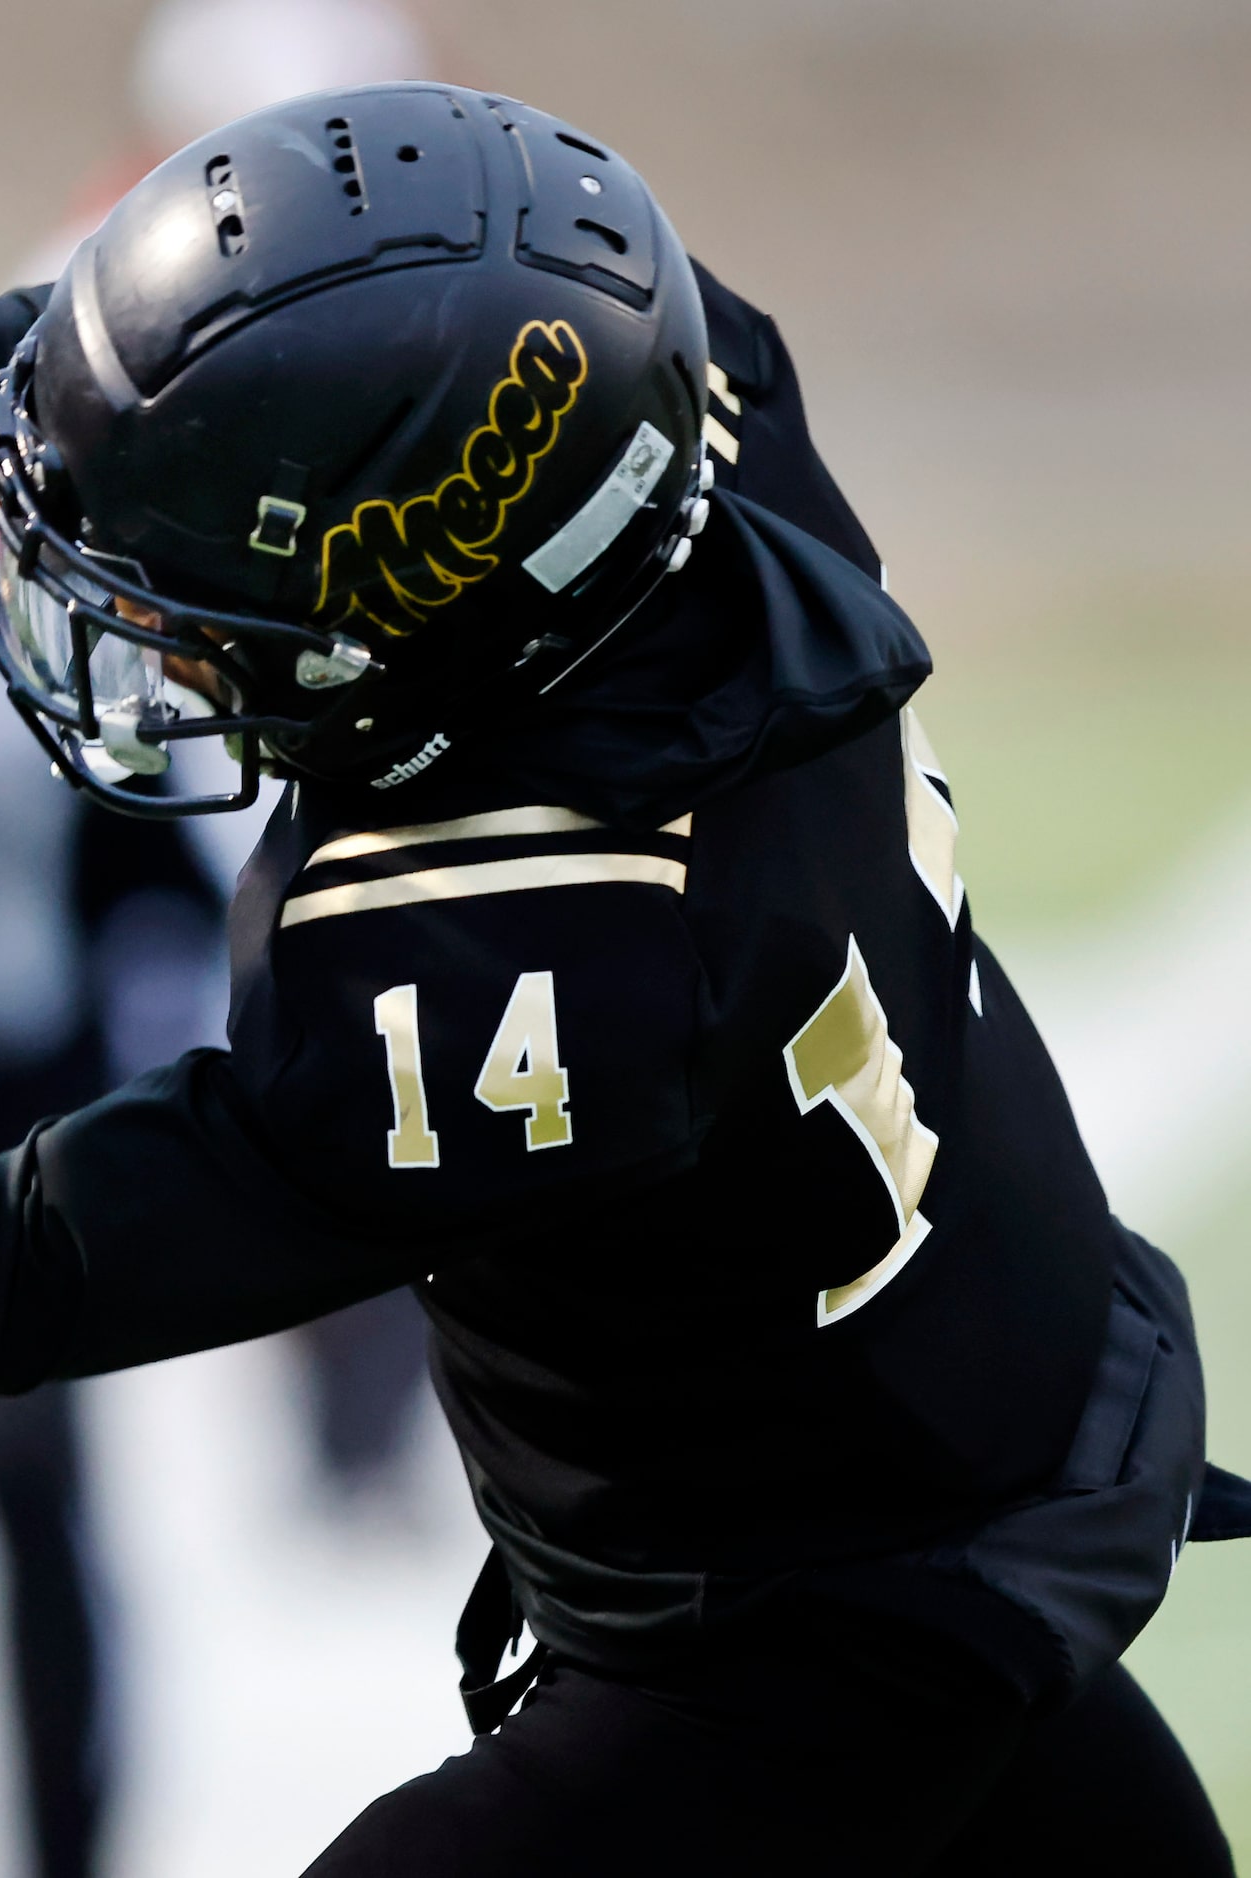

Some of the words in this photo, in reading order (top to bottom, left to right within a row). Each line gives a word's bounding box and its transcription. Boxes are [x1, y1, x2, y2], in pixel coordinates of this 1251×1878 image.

[312, 319, 588, 636] Mecca
[370, 732, 451, 789] schutt
[373, 970, 574, 1169] 14
